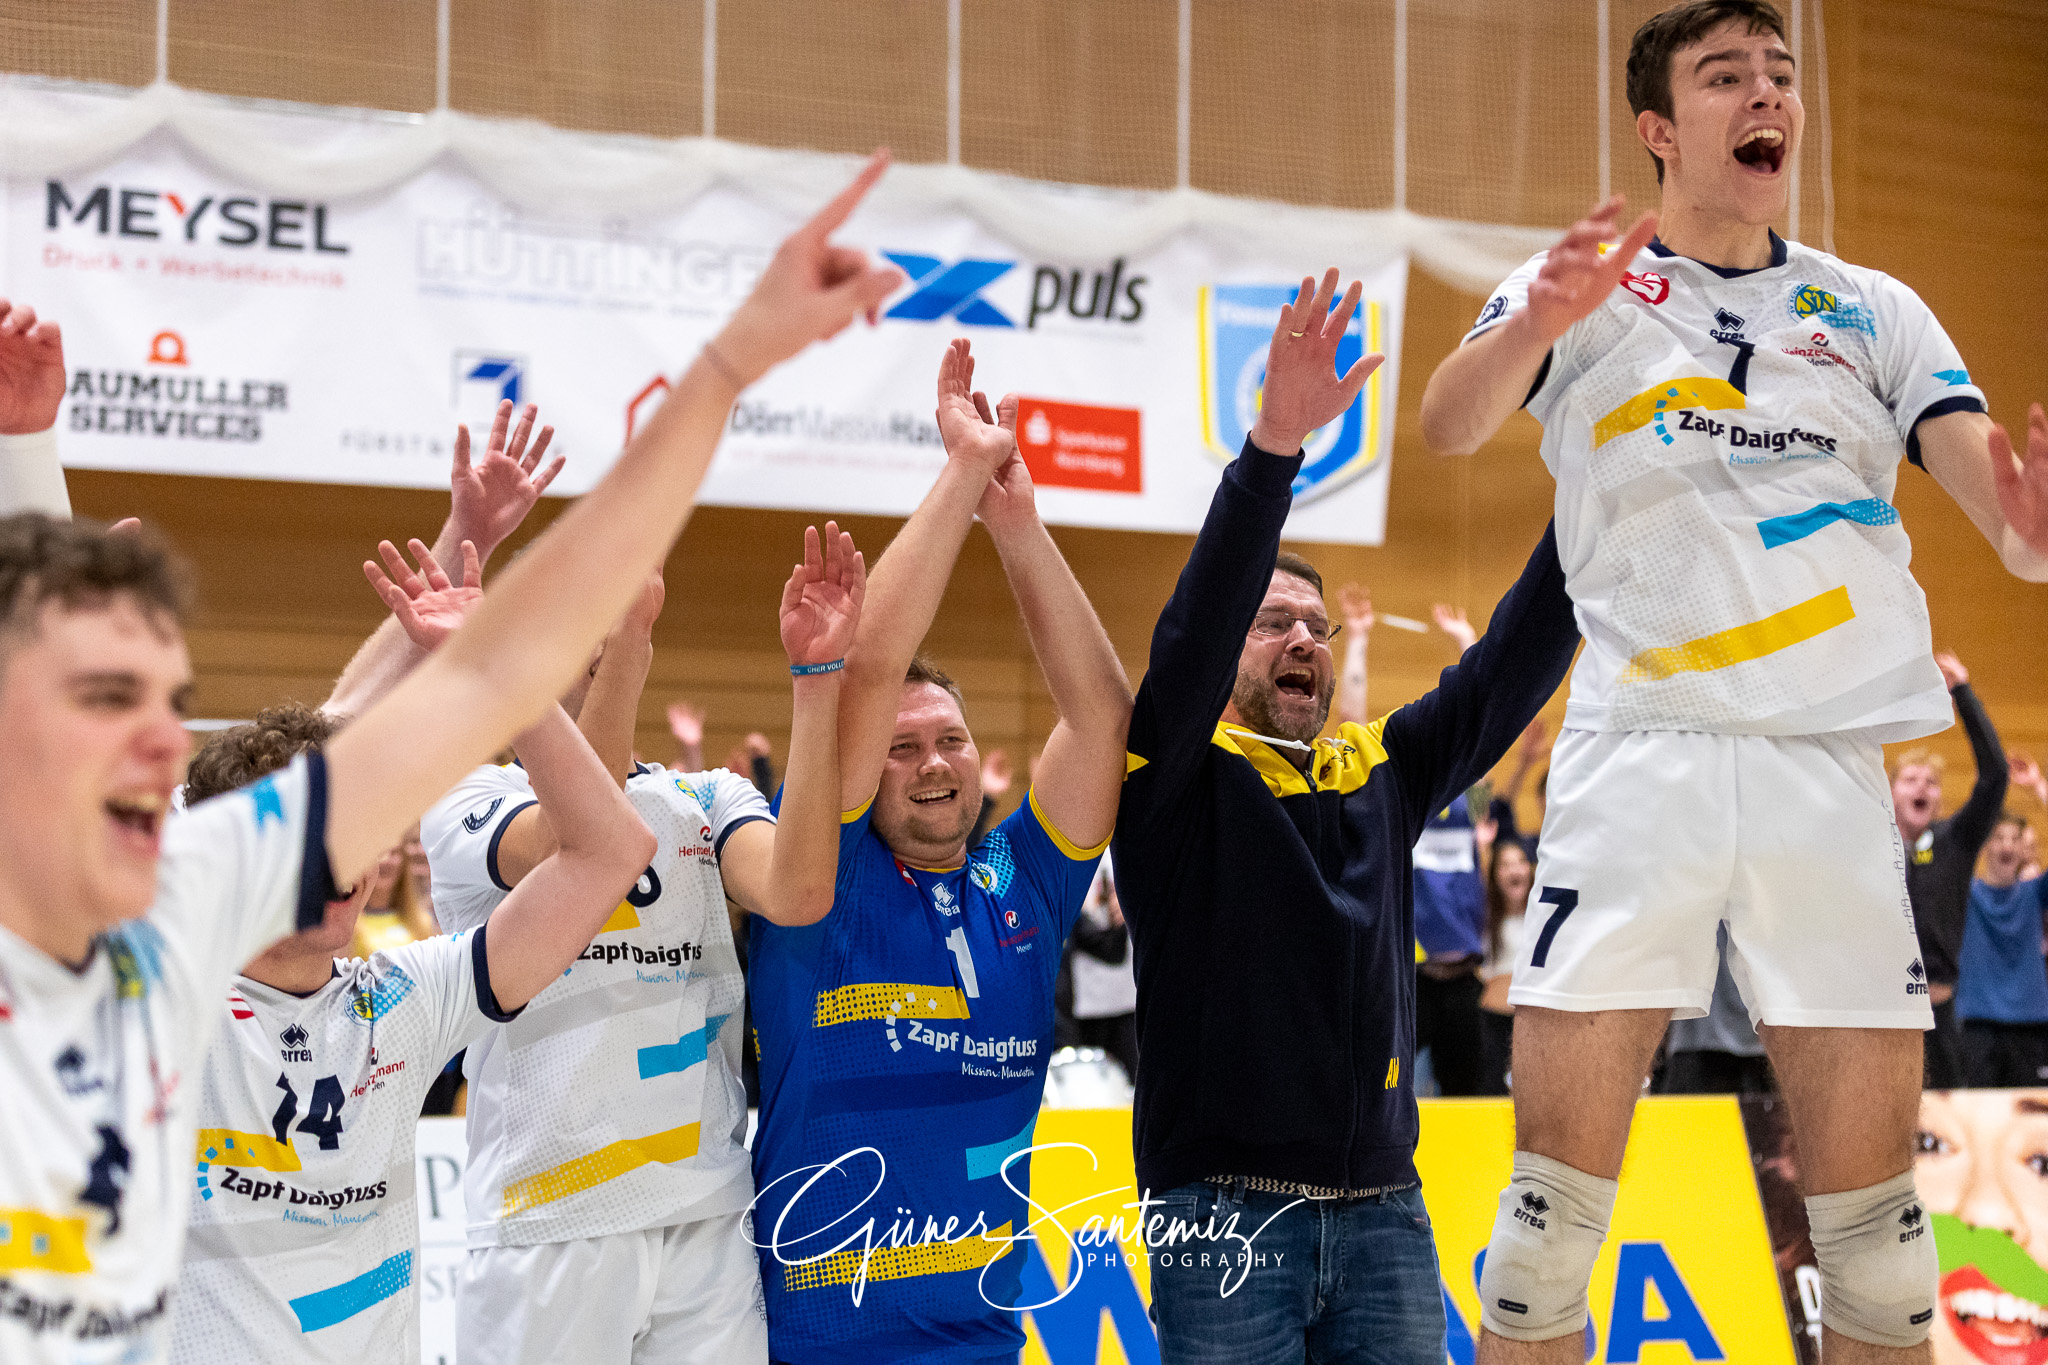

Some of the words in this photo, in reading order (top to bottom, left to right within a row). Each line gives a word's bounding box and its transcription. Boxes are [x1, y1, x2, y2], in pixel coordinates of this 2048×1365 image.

[46, 181, 350, 254] MEYSEL
[1716, 333, 1756, 396] 7
[70, 403, 263, 443] SERVICES
[1530, 886, 1578, 967] 7
[945, 926, 981, 998] 1
[907, 1020, 960, 1053] Zapf
[963, 1035, 1037, 1063] Daigfuss
[272, 1072, 346, 1150] 14
[220, 1167, 286, 1202] Zapf
[288, 1180, 388, 1211] Daigfuss
